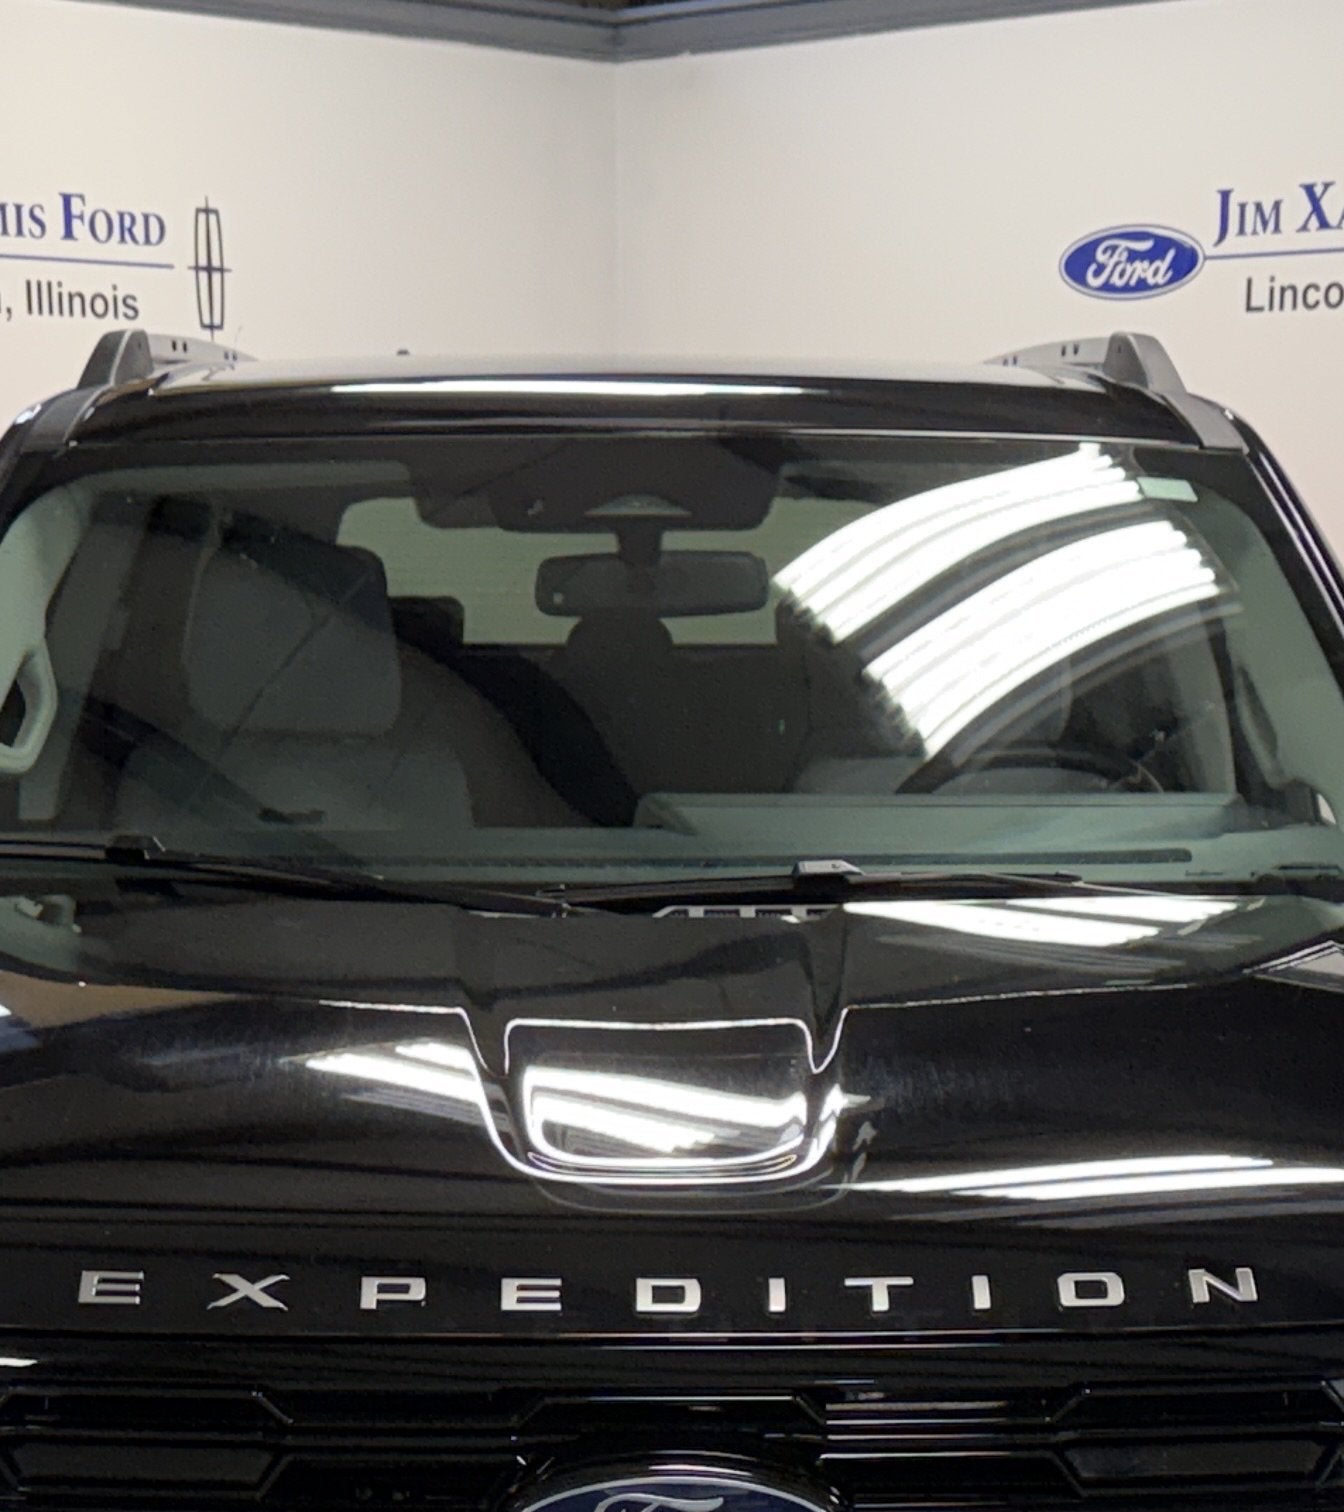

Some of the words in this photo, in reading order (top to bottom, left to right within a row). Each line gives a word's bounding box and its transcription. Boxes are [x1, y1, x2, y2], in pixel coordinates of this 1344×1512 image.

[59, 192, 167, 248] FORD
[1213, 188, 1283, 246] JIM
[1085, 237, 1173, 289] Ford
[25, 279, 140, 322] Illinois
[77, 1266, 1259, 1314] EXPEDITION
